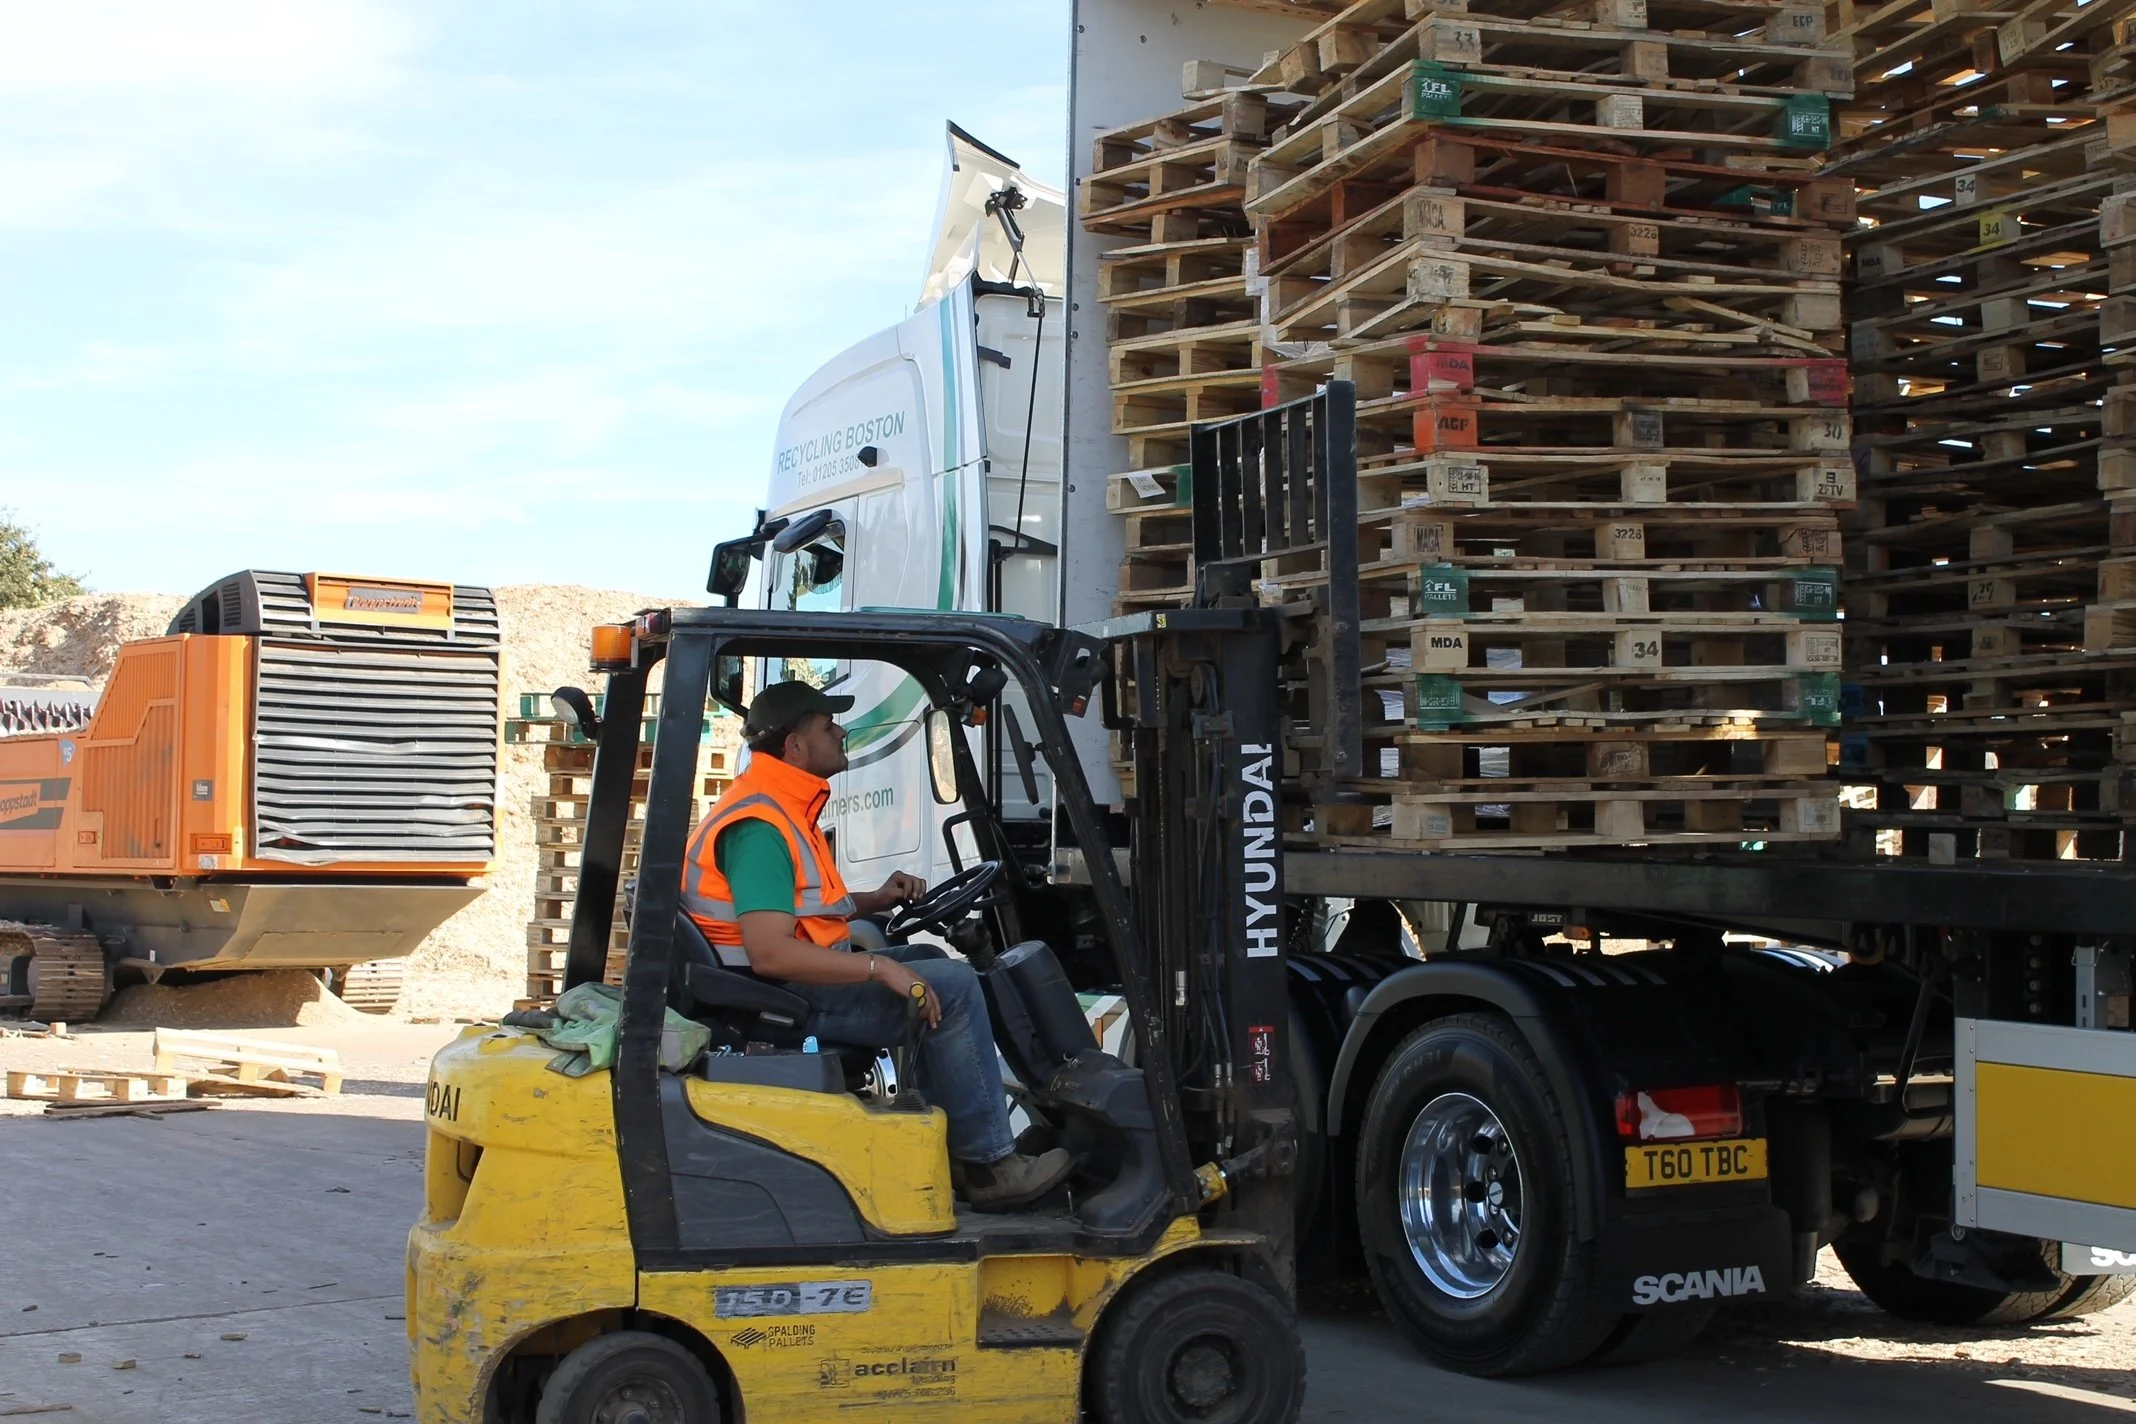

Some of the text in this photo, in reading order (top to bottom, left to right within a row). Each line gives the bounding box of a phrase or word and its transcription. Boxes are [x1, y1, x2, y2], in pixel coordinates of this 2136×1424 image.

[1956, 179, 1976, 193] 34
[1983, 222, 2000, 236] 34
[777, 411, 905, 475] RECYCLING BOSTON
[797, 471, 811, 488] Tel:
[812, 461, 837, 482] 01205
[1424, 593, 1457, 601] PALLETS
[1431, 637, 1463, 649] MDA
[1633, 641, 1660, 659] 34
[1241, 743, 1278, 958] HYUNDAI
[1644, 1145, 1748, 1181] T60 TBC
[1632, 1265, 1766, 1305] SCANIA
[768, 1325, 815, 1337] SPALDING
[769, 1337, 814, 1348] PALLETS
